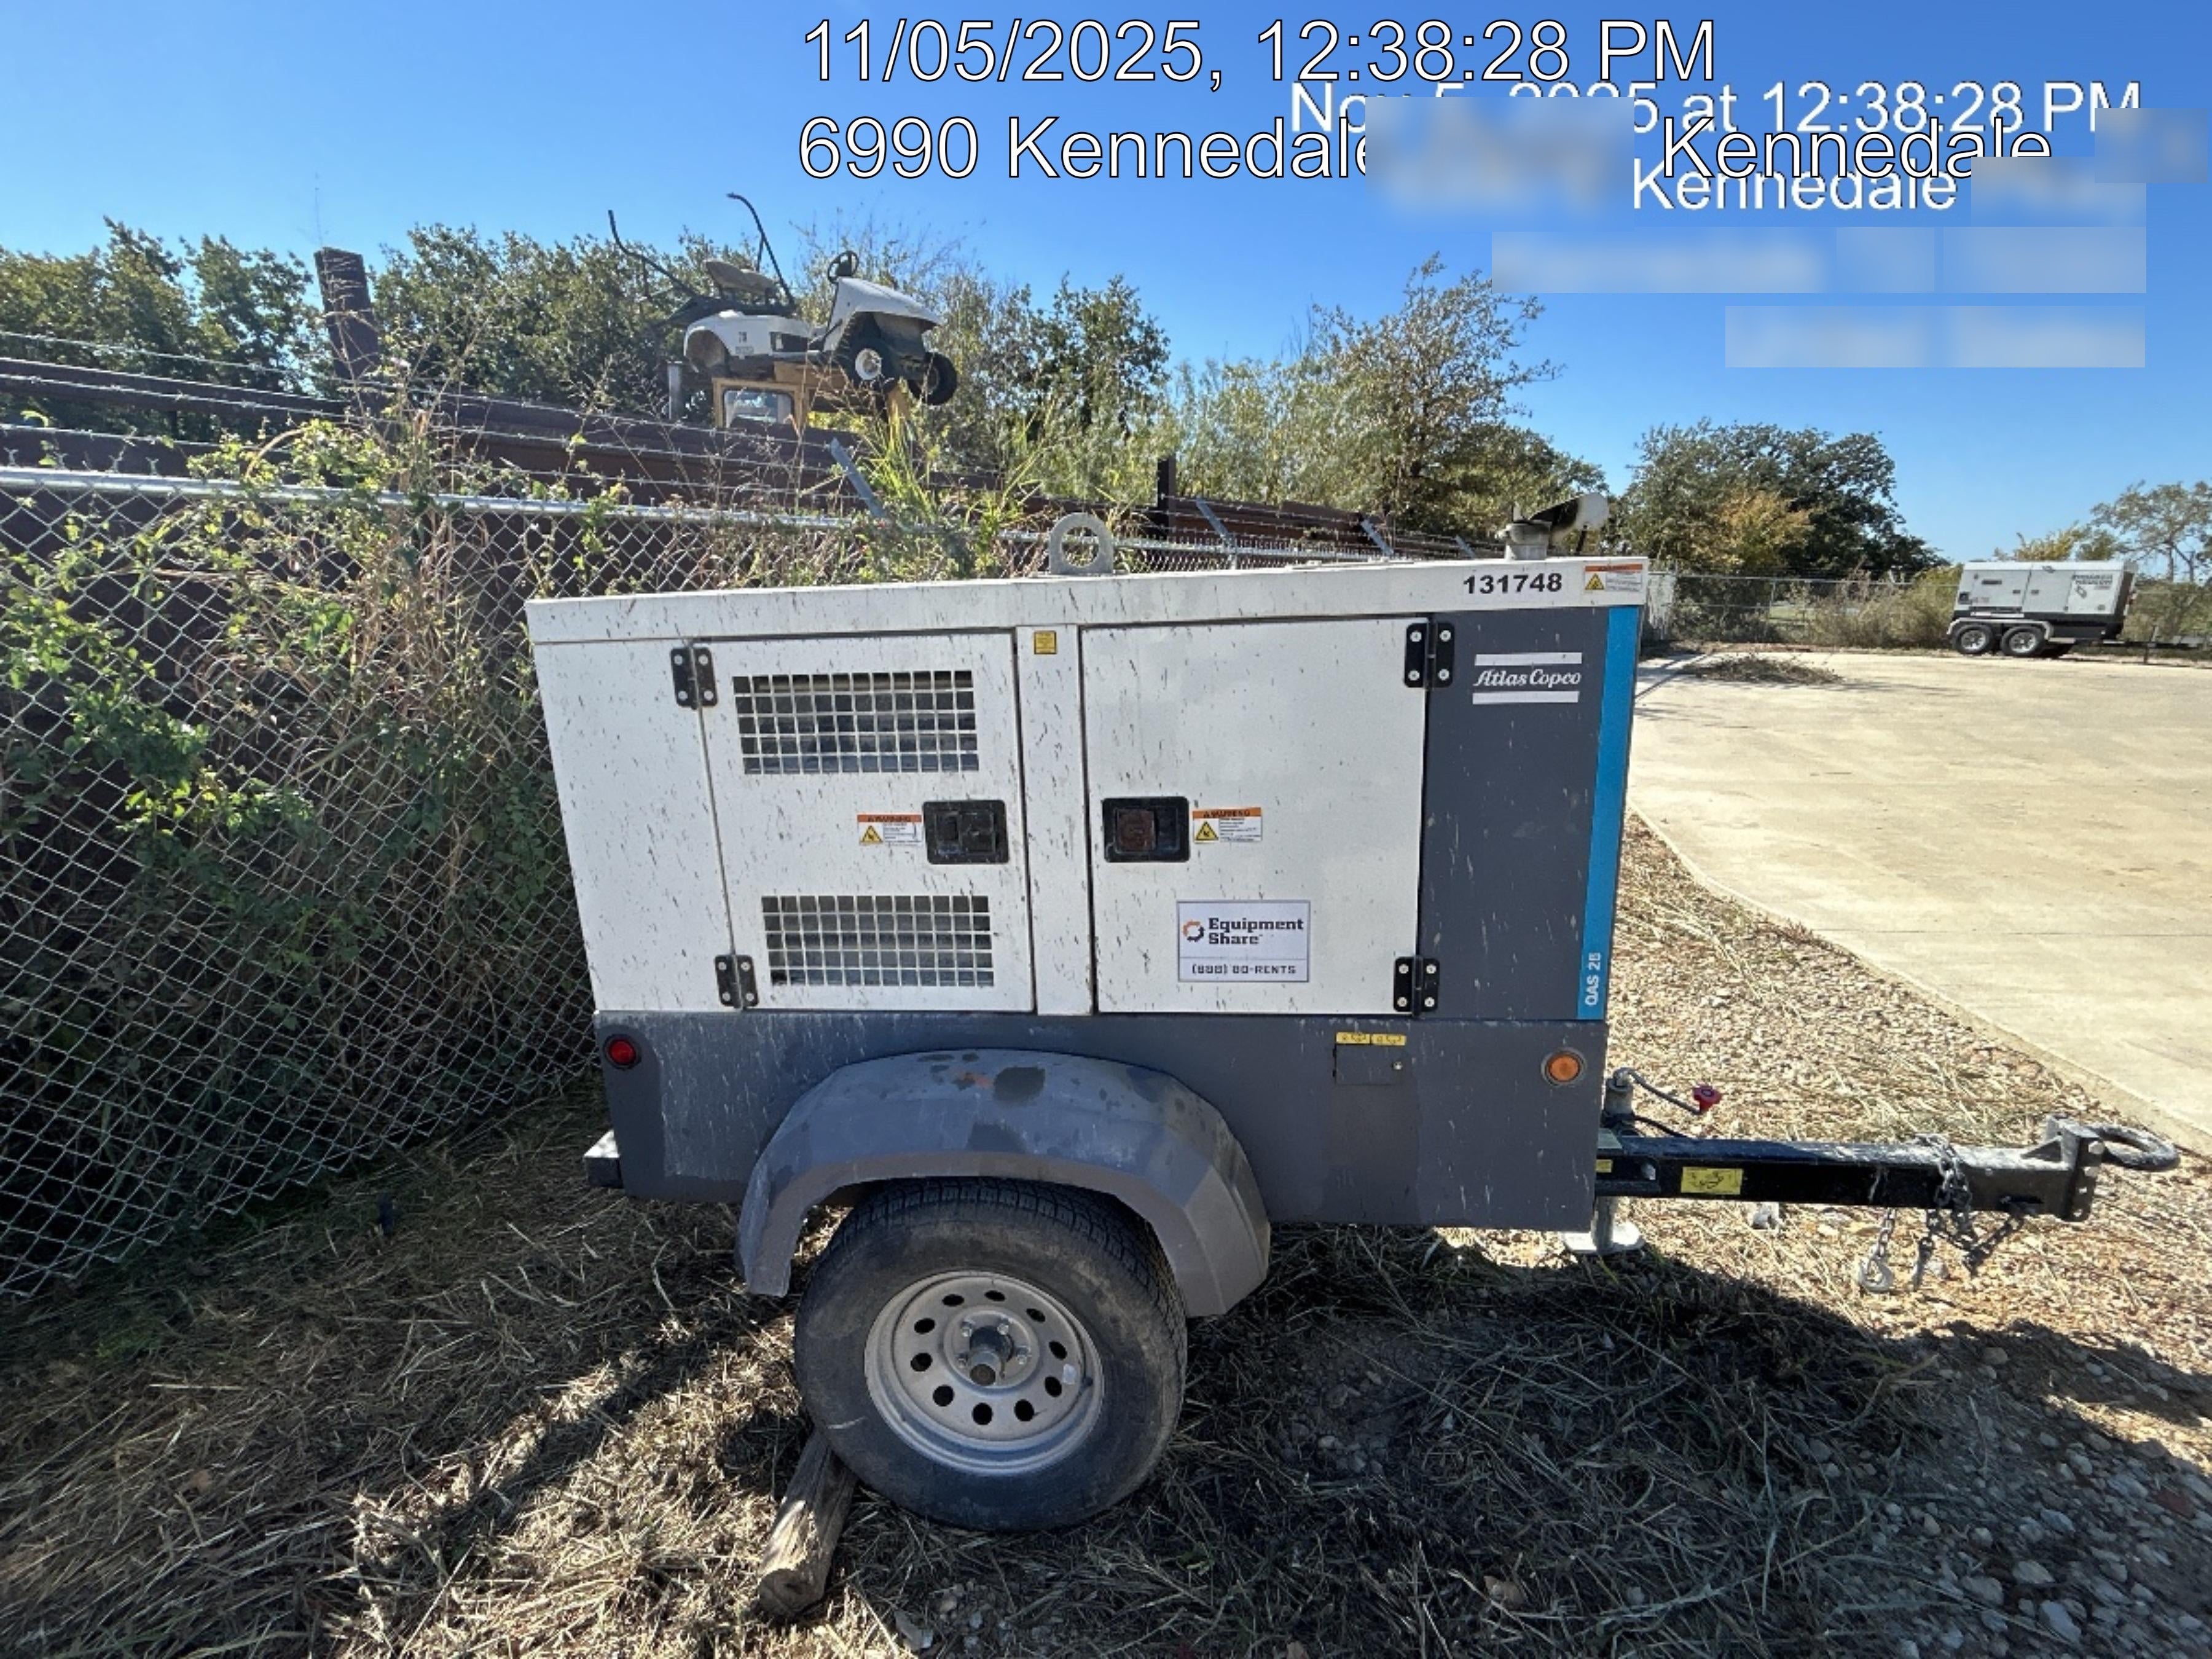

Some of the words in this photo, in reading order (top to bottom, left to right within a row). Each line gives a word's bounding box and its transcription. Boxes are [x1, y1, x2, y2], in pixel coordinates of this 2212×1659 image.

[1463, 573, 1563, 594] 131748
[1473, 669, 1528, 687] Atlas
[1529, 669, 1582, 688] Copco
[1208, 917, 1304, 933] Equipment
[1208, 932, 1260, 944] Share
